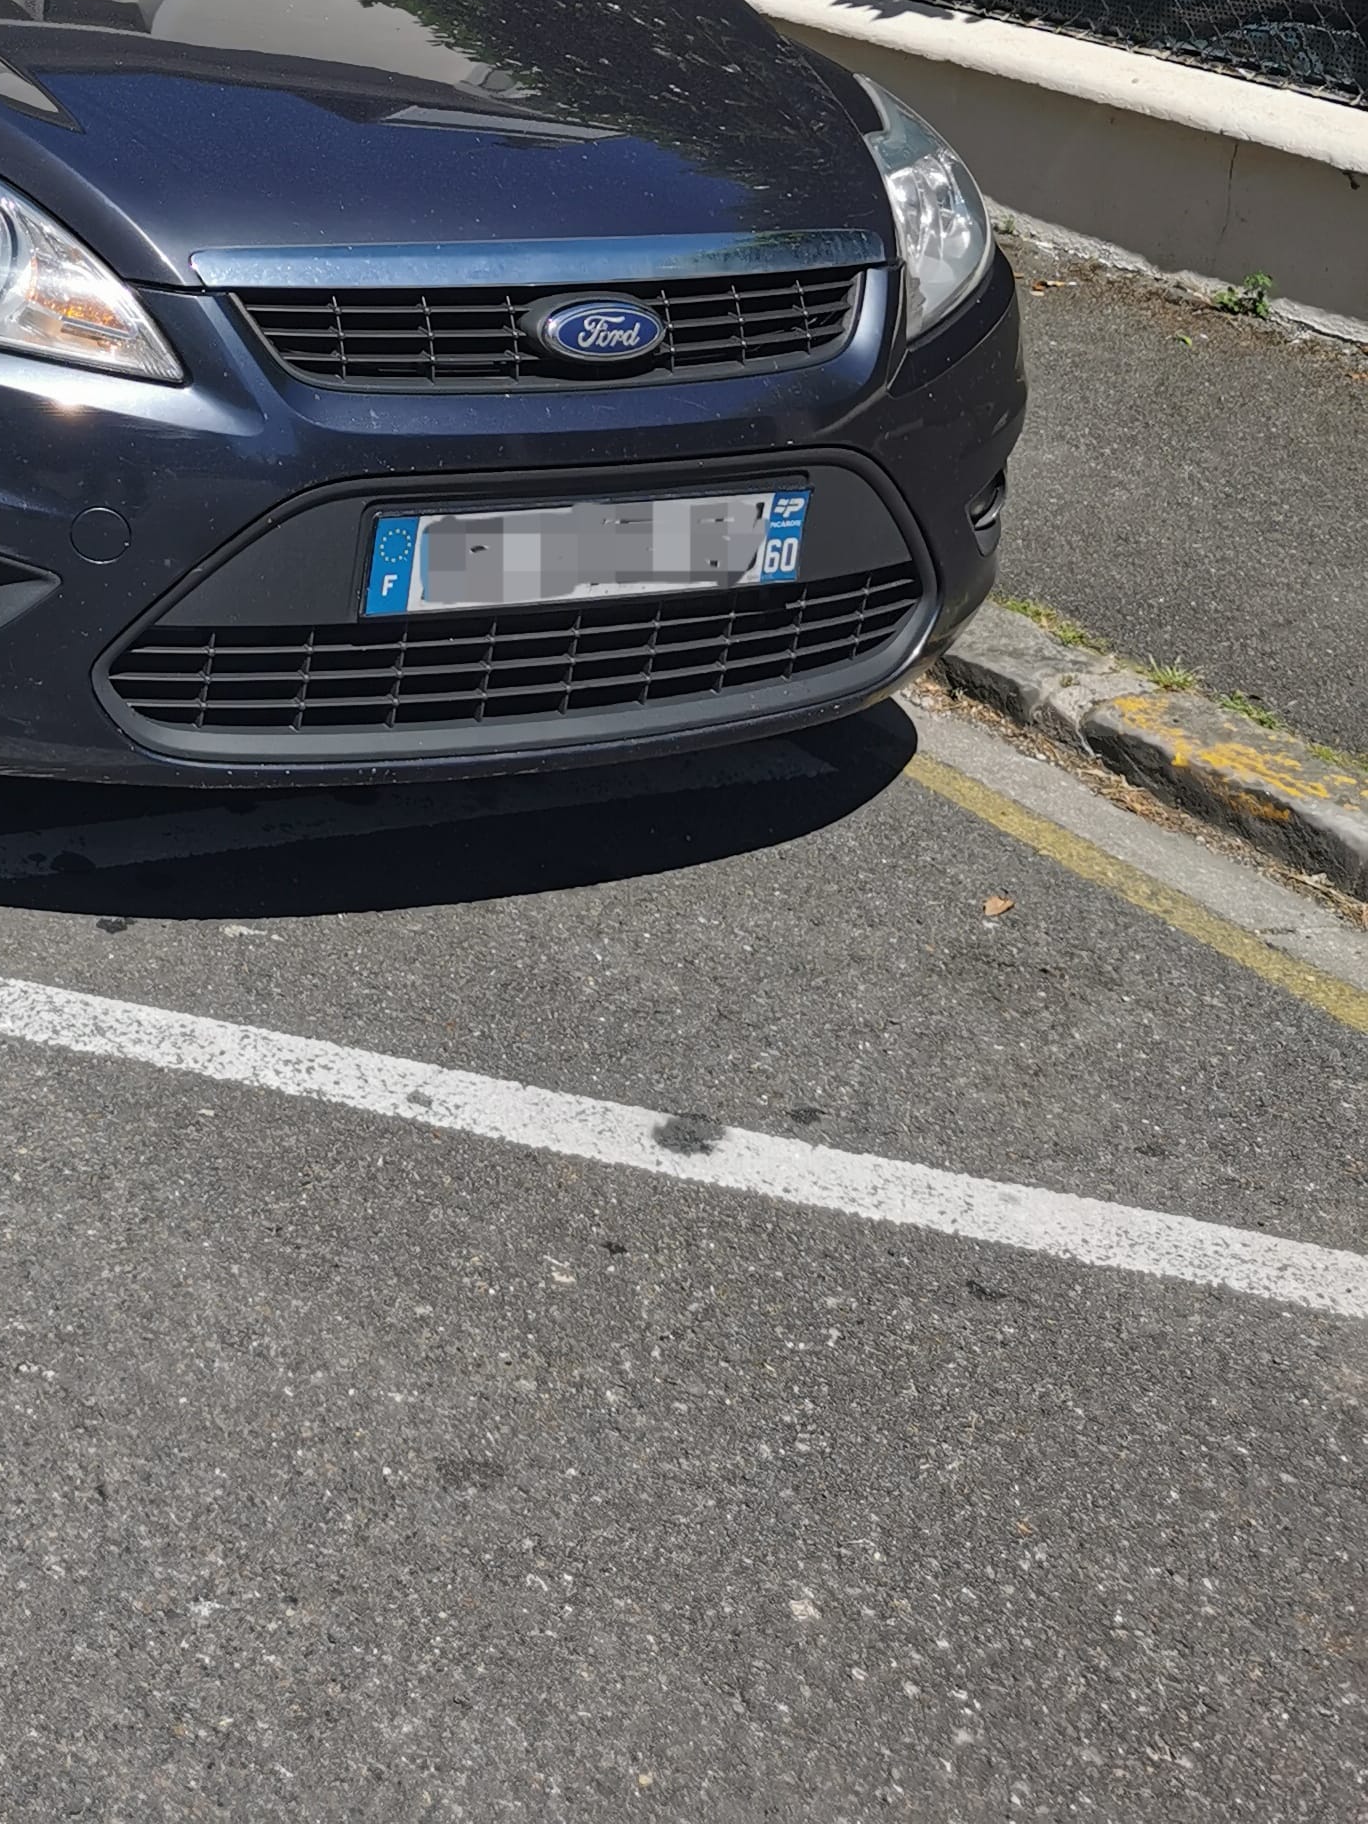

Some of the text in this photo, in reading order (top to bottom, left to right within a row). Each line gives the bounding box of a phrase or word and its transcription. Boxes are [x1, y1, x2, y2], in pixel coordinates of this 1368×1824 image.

[577, 315, 641, 348] Ford
[763, 537, 799, 573] 60
[381, 574, 398, 597] F
